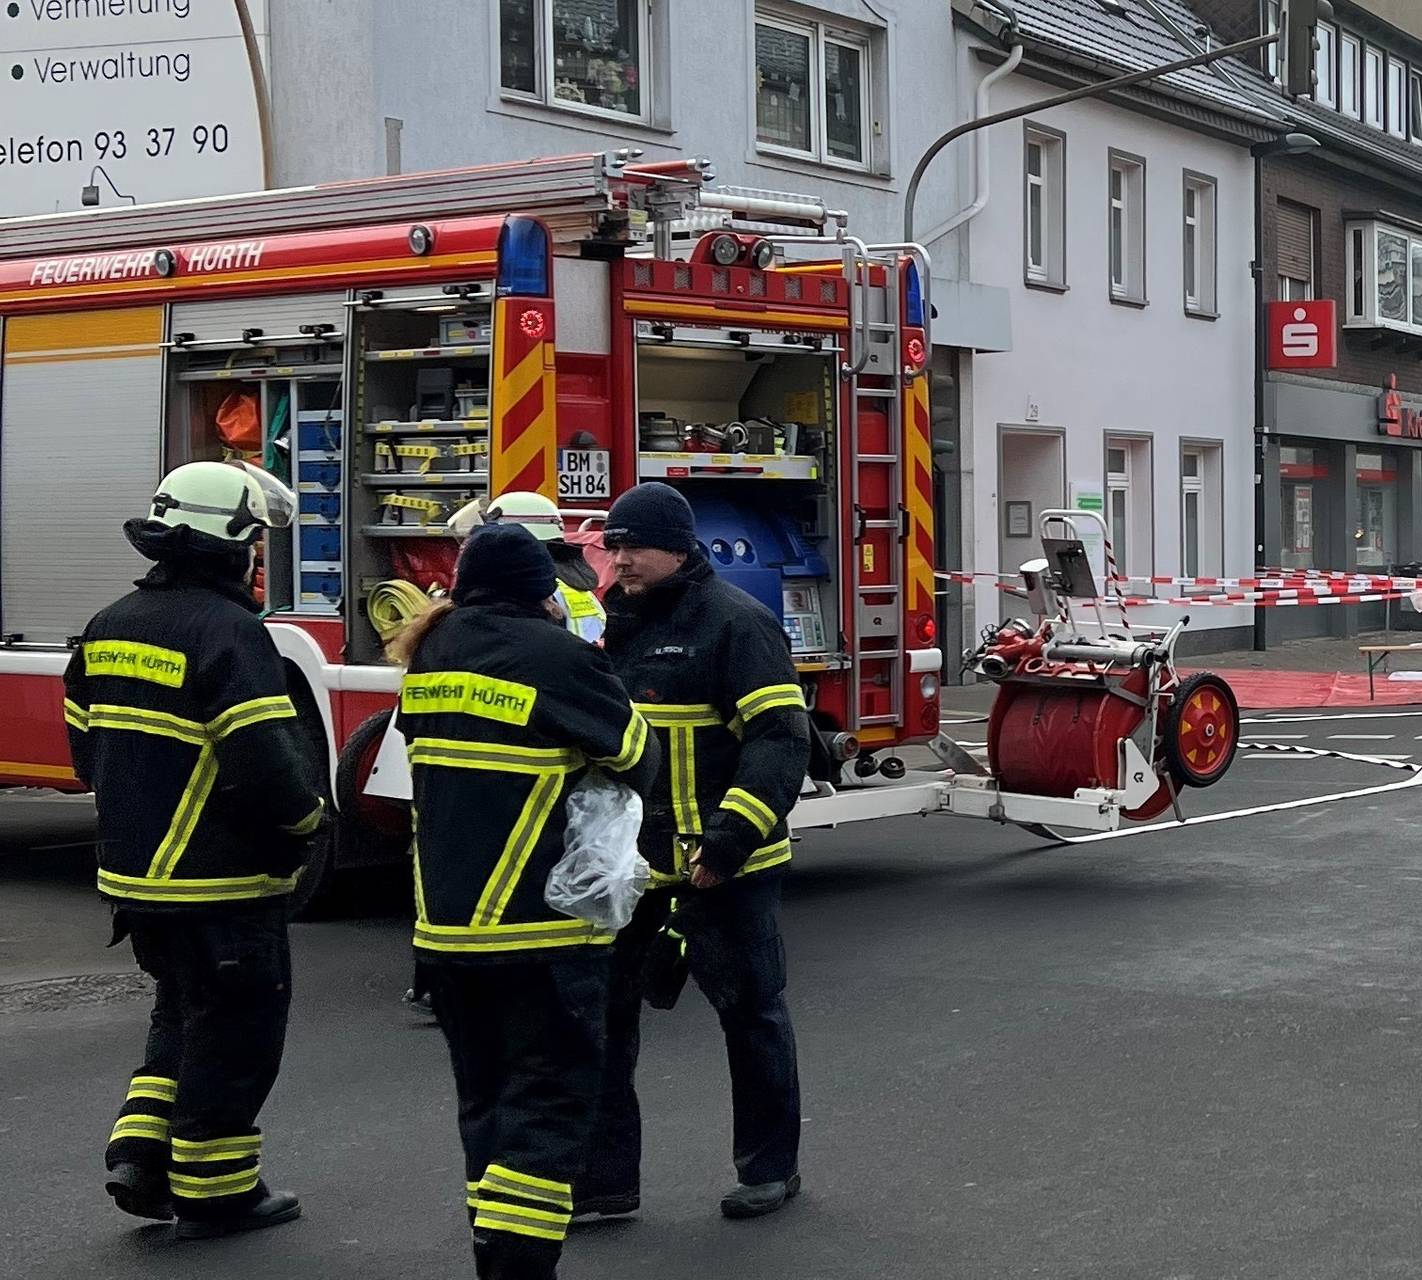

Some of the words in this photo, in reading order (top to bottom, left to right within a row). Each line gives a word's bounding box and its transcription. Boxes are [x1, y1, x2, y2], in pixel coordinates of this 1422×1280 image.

[34, 51, 190, 83] Verwaltung
[94, 130, 127, 160] 93
[145, 127, 175, 157] 37
[192, 123, 229, 154] 90
[30, 251, 155, 286] FEUERWEHR
[567, 452, 590, 472] BM
[559, 474, 581, 494] SH
[585, 474, 606, 494] 84
[471, 687, 526, 713] HÜRTH
